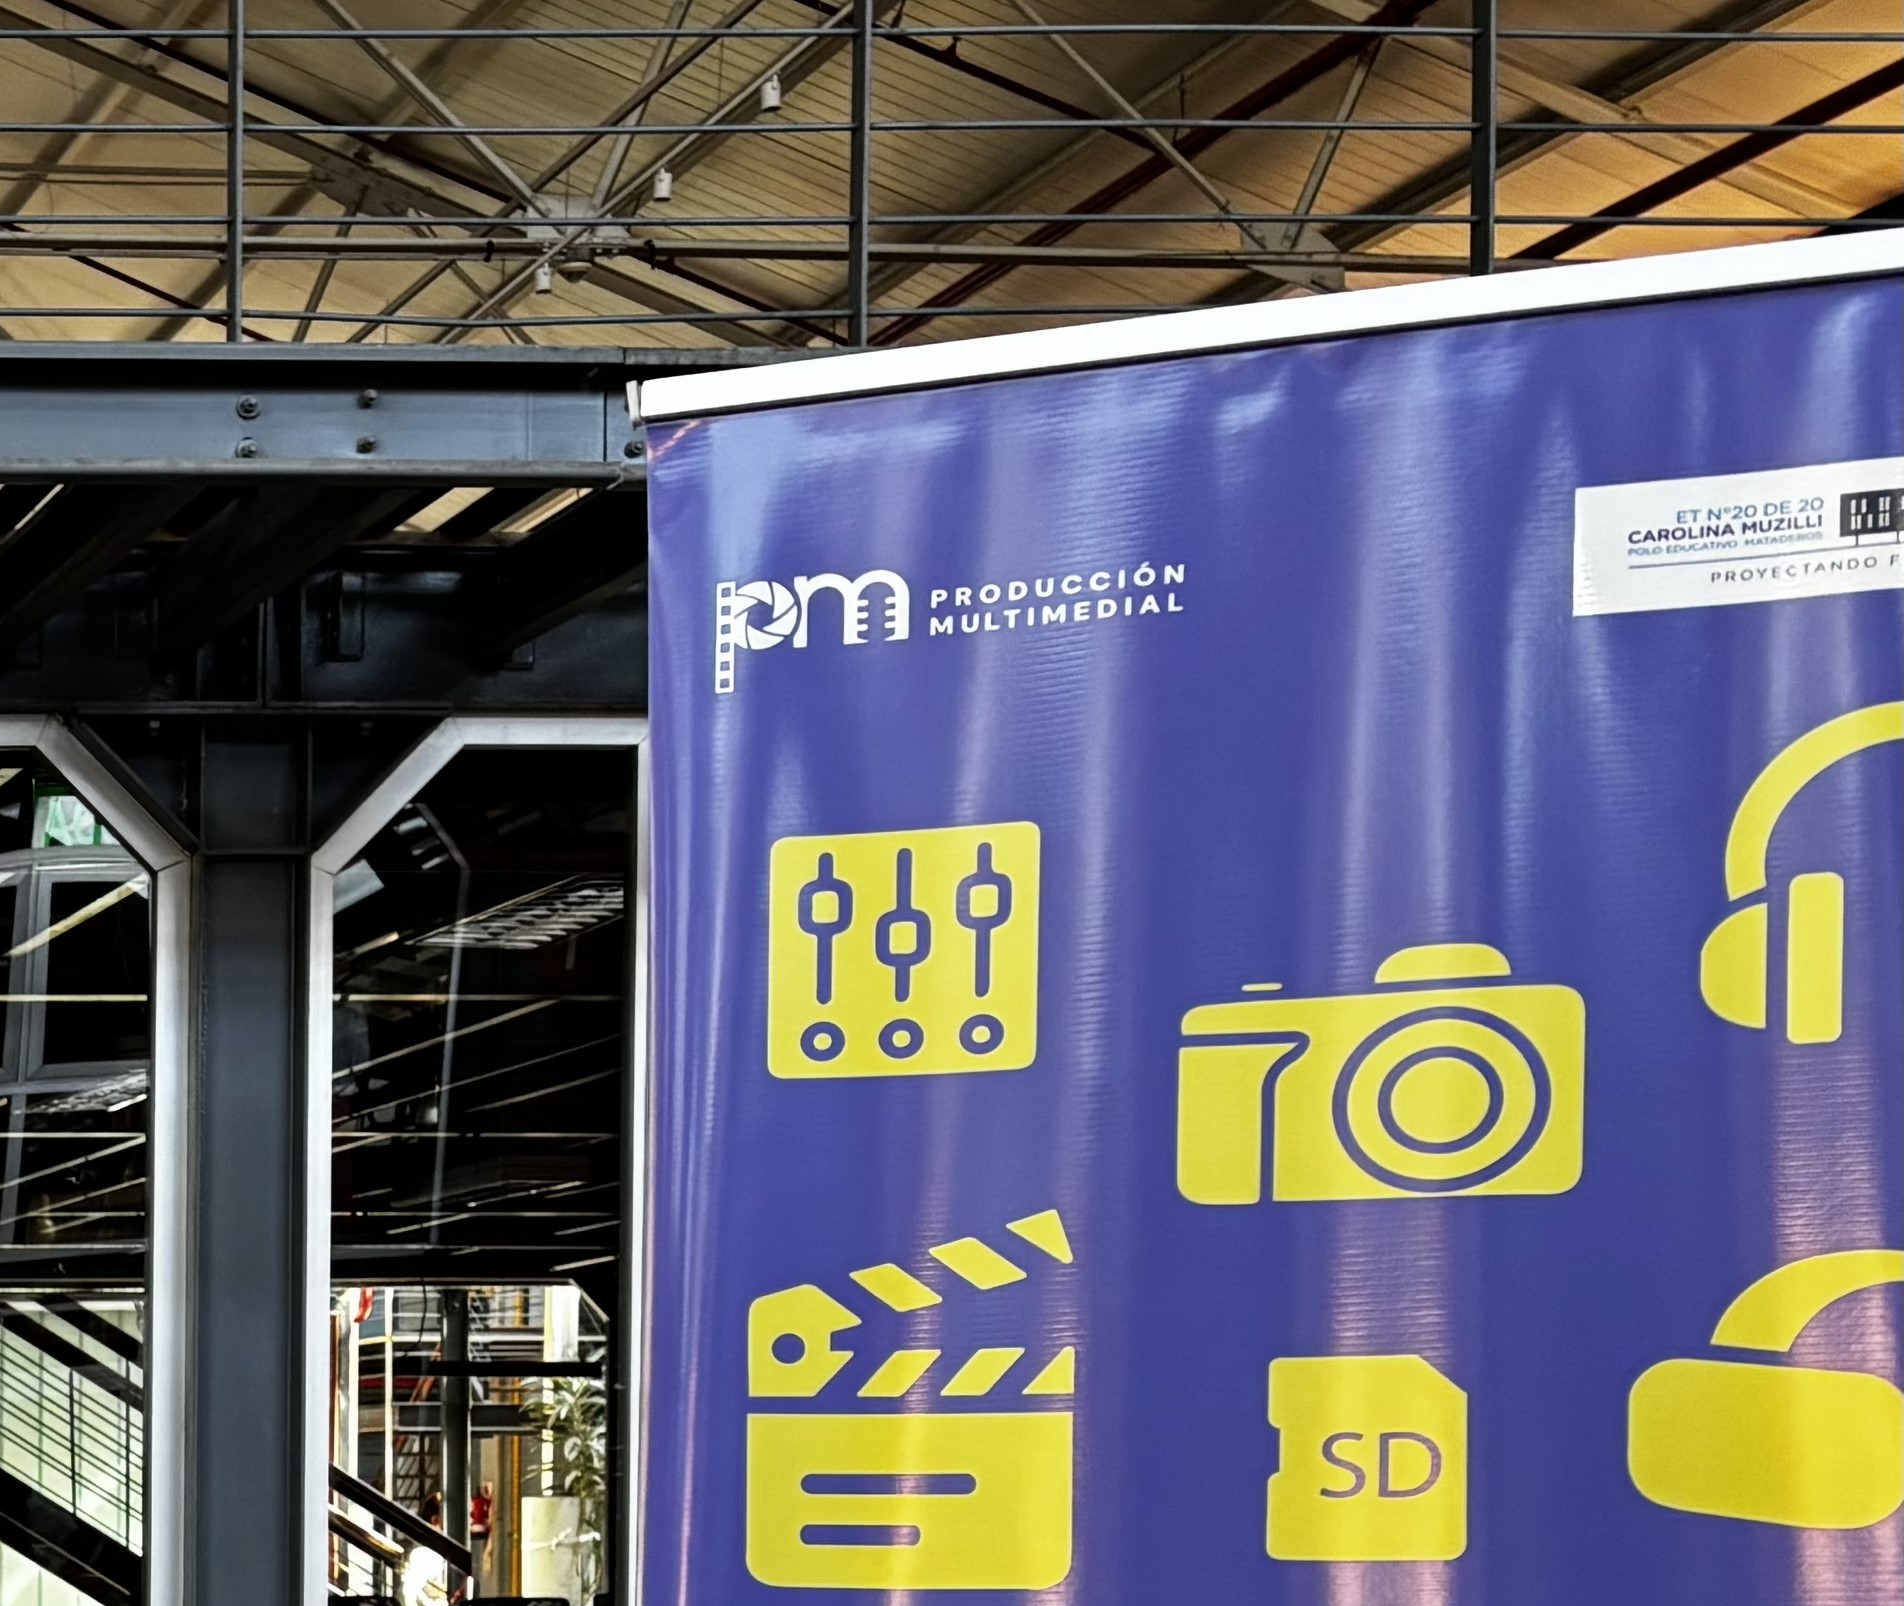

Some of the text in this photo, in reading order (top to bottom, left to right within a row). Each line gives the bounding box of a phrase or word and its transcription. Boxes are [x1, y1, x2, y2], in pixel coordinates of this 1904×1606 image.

[1676, 508, 1701, 525] ET
[1763, 500, 1792, 517] DE
[1799, 496, 1824, 512] 20
[1627, 514, 1823, 545] CAROLINA MUZILLI
[1627, 531, 1823, 557] POLO EDUCATIVO MATADEROS
[929, 561, 1186, 608] PRODUCCIÓN
[1710, 555, 1878, 584] PROYECTANDO
[929, 593, 1185, 636] MULTIMEDIAL
[1318, 1430, 1444, 1500] SD
